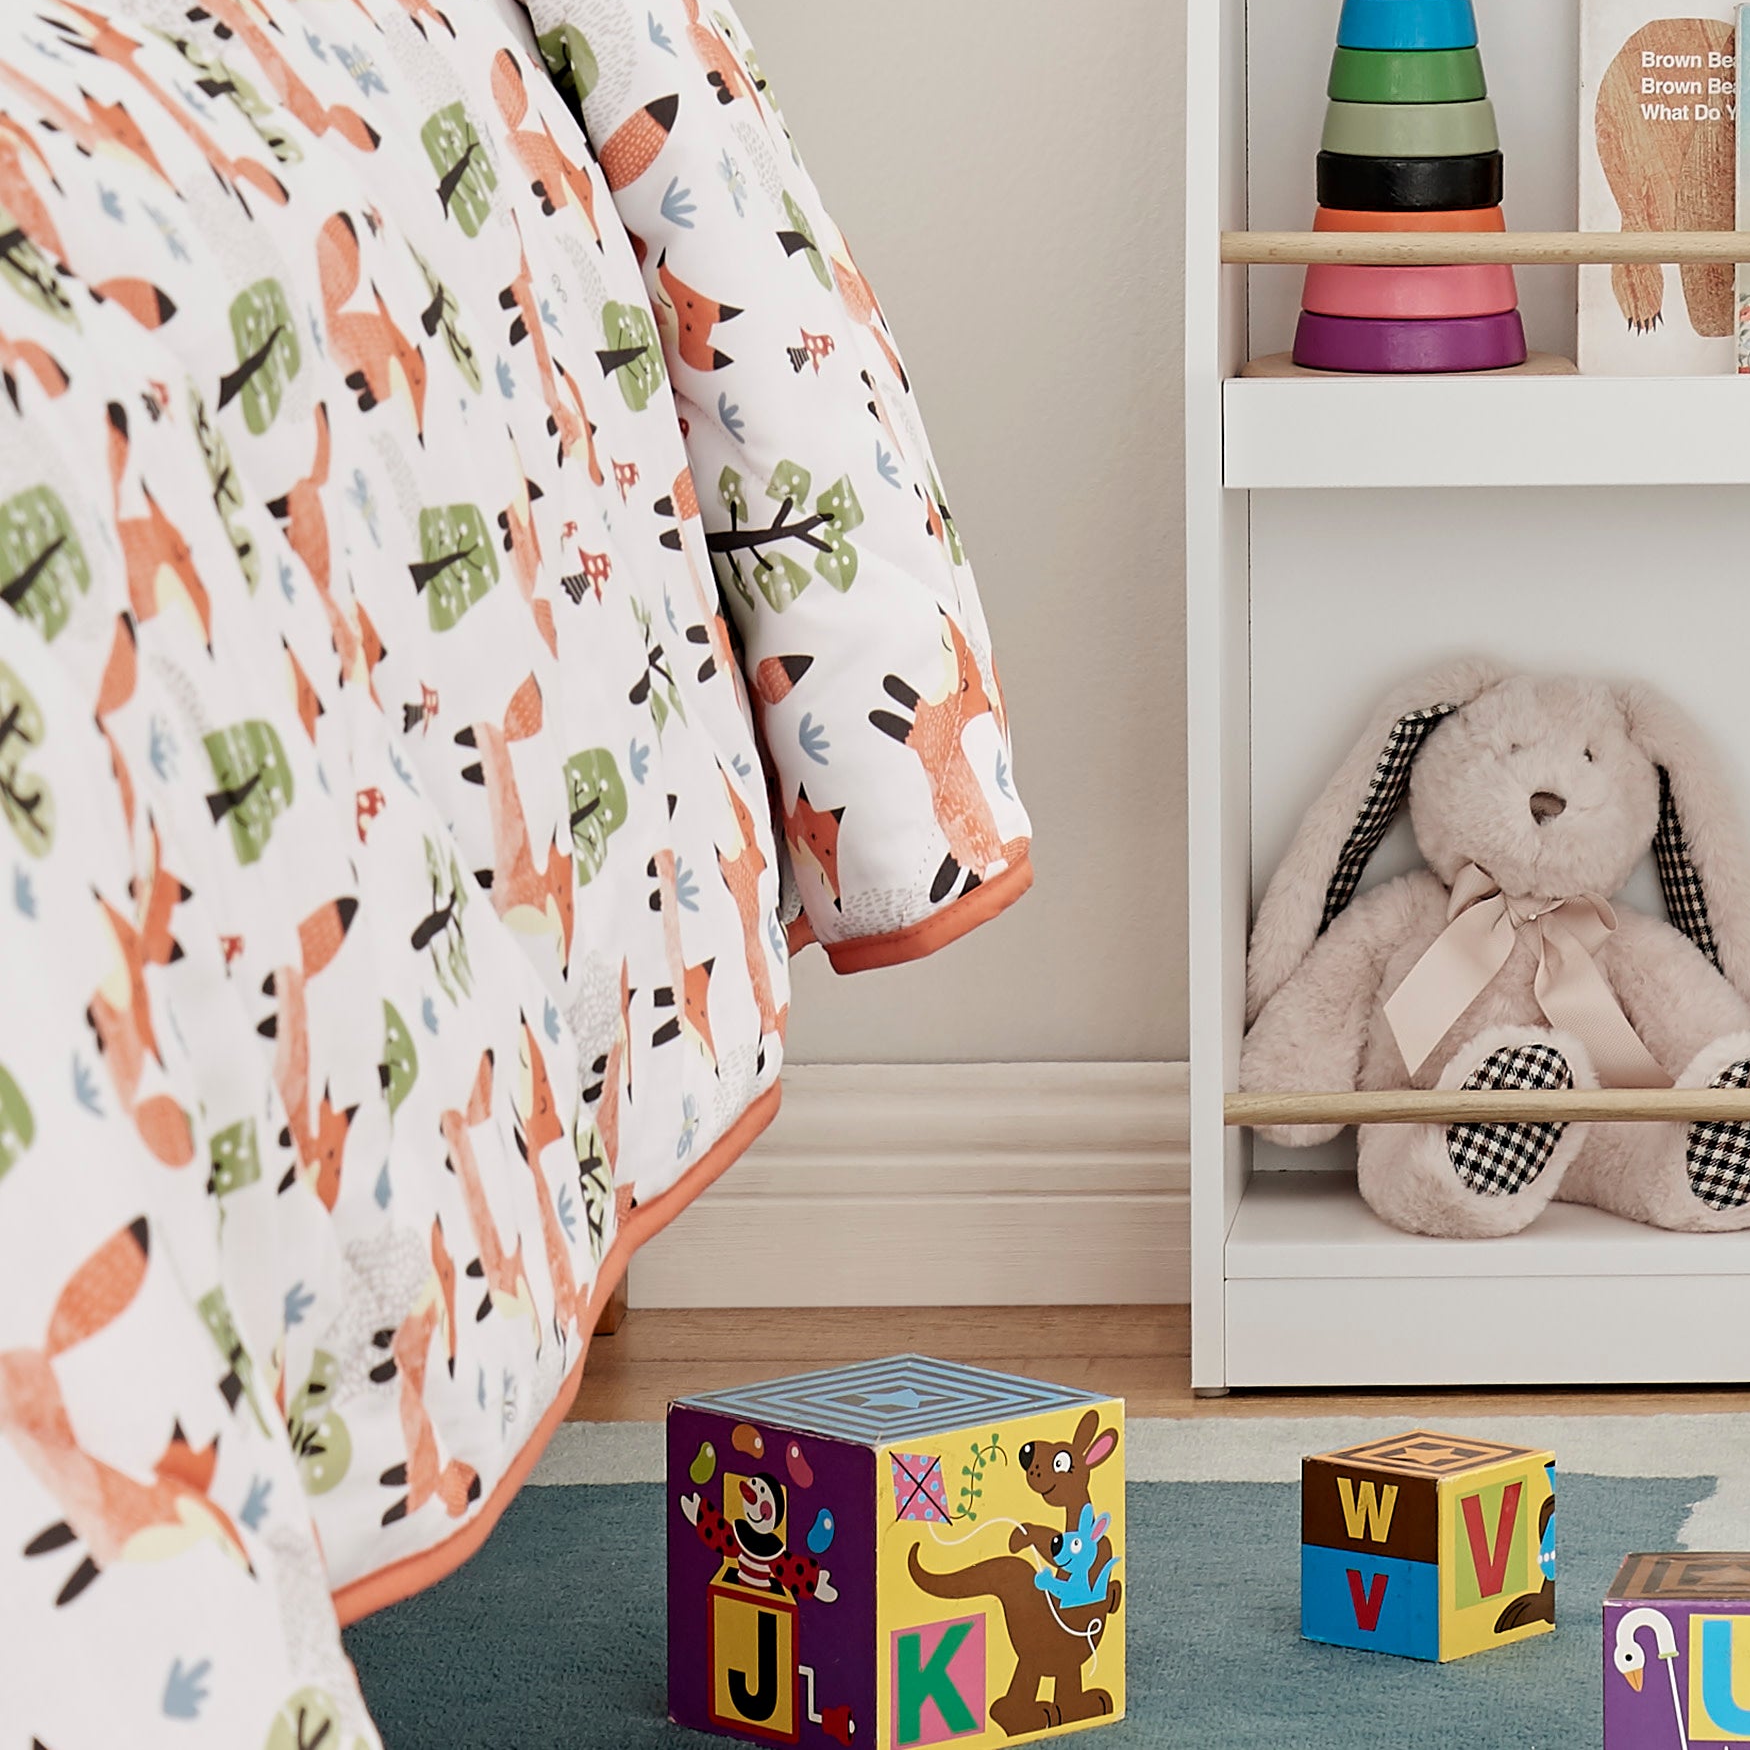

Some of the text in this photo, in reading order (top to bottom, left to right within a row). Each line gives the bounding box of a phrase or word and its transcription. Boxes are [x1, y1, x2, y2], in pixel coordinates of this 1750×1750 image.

[1641, 51, 1702, 69] Brown
[1641, 77, 1702, 95] Brown
[1641, 103, 1690, 121] What
[1695, 103, 1720, 121] Do
[1336, 1476, 1399, 1544] W
[1460, 1481, 1524, 1600] V
[1346, 1568, 1389, 1632] V
[727, 1611, 778, 1722] J
[897, 1620, 978, 1746] K
